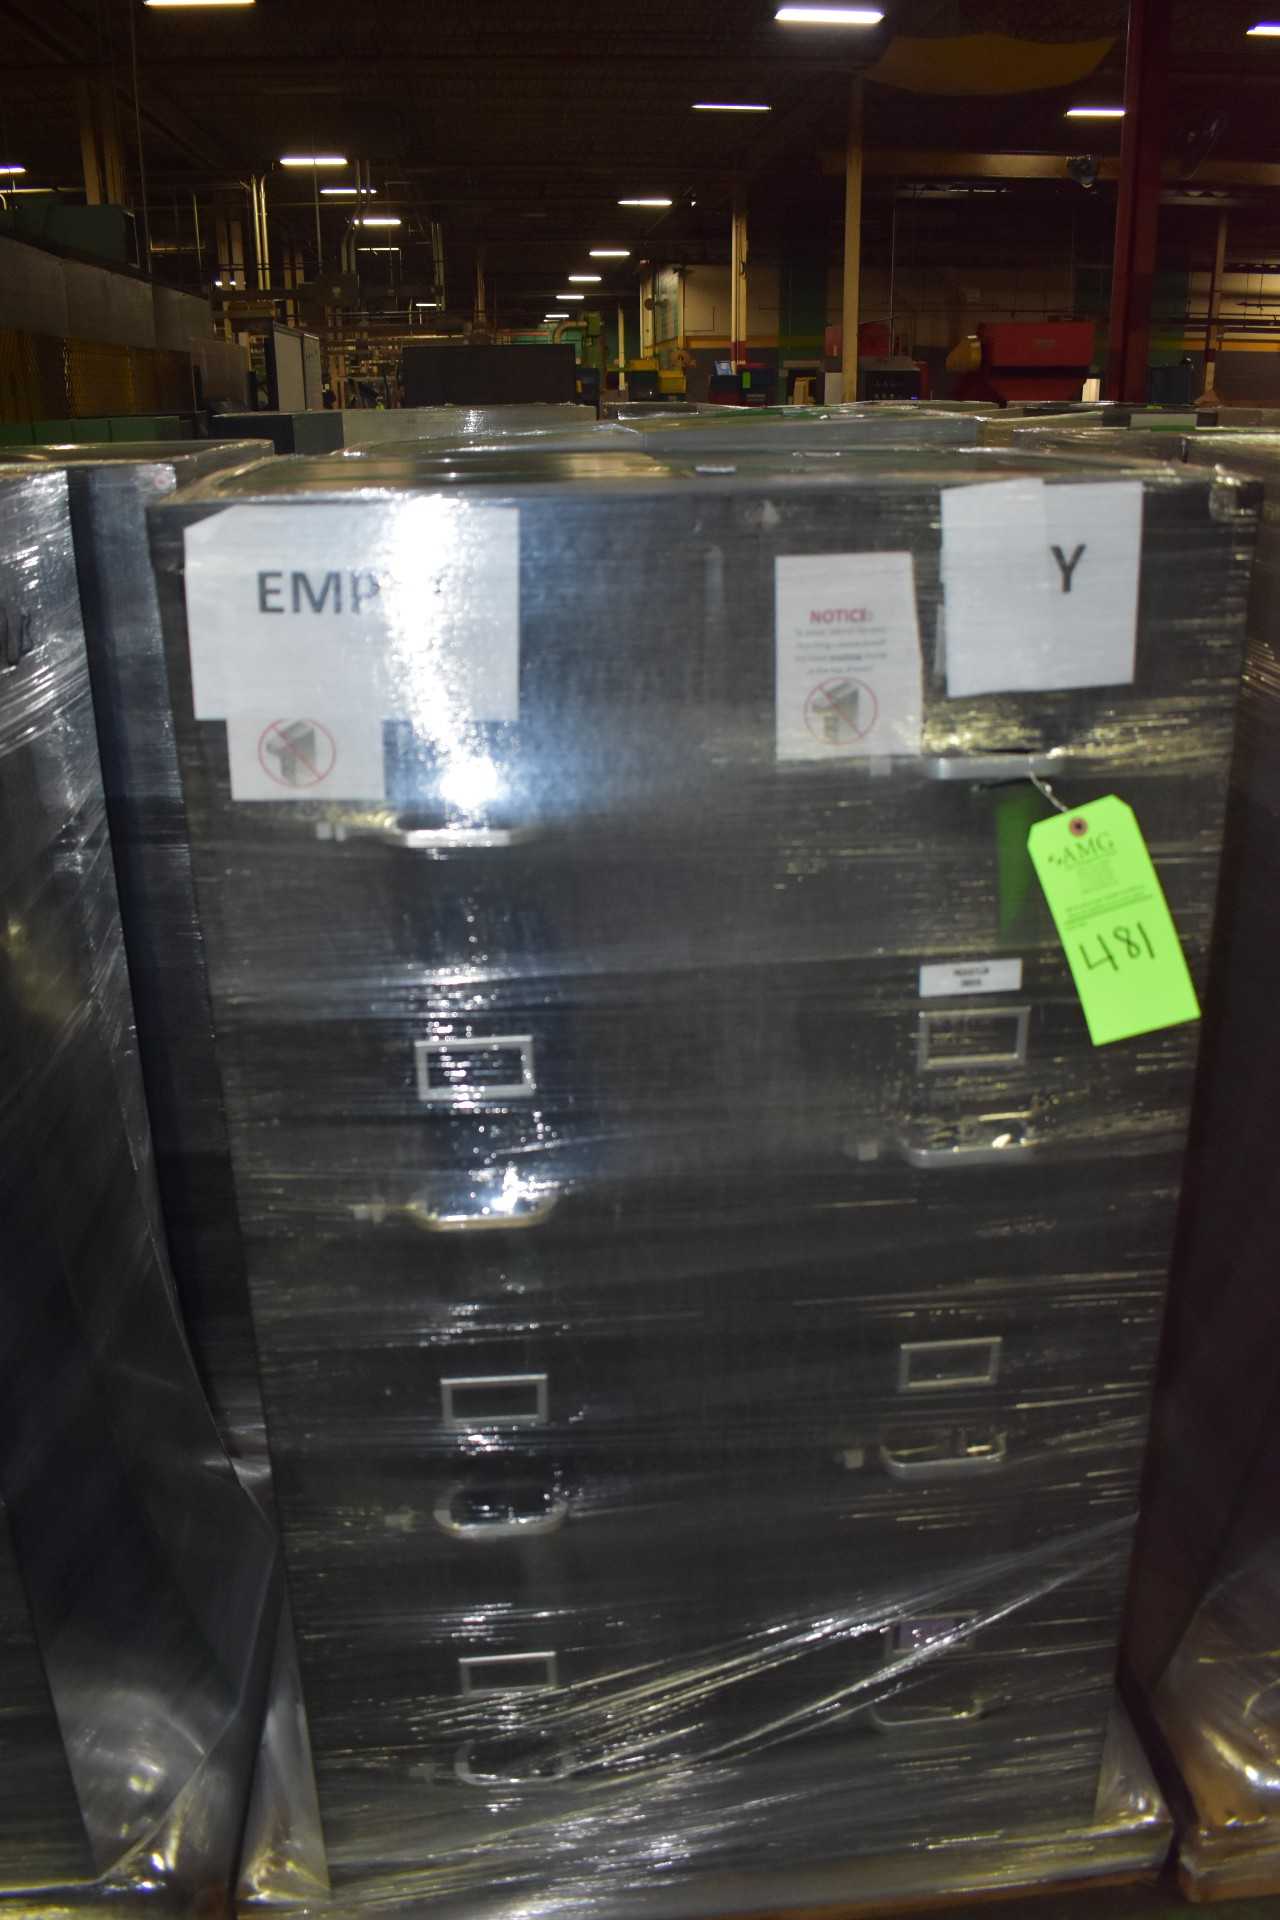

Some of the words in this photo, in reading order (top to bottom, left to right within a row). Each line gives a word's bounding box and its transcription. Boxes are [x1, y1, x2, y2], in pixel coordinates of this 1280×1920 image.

[257, 570, 382, 615] EMP
[1050, 543, 1087, 593] Y
[1078, 921, 1156, 972] 481
